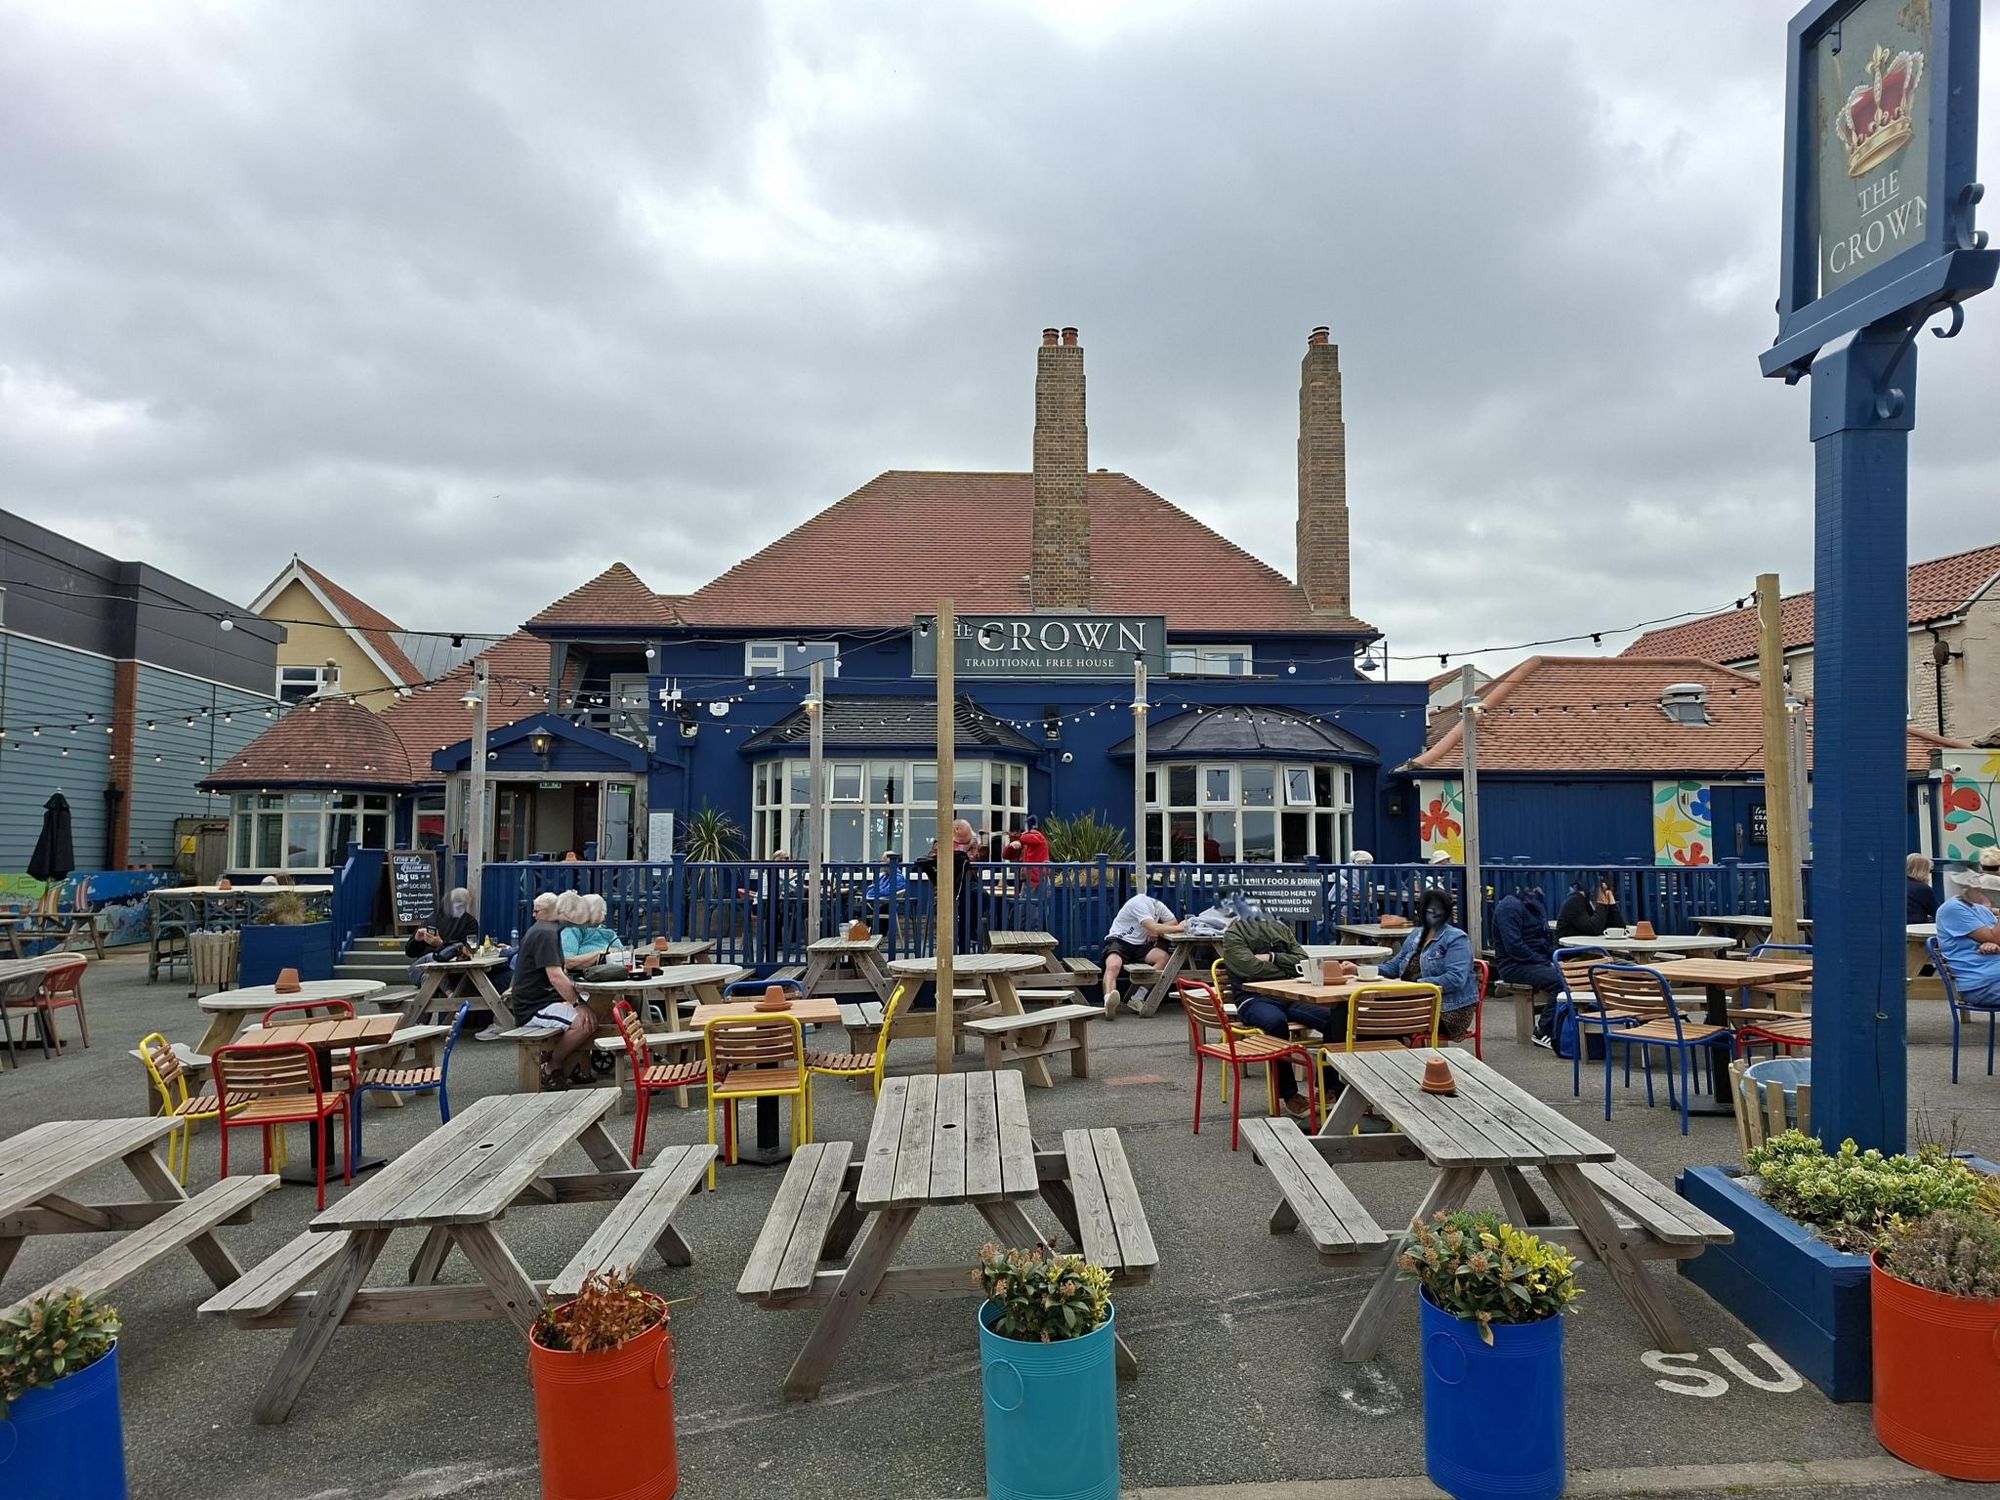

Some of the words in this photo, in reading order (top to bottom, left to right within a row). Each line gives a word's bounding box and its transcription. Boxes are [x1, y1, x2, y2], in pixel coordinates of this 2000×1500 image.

[1858, 170, 1900, 212] THE
[978, 621, 1147, 652] CROWN
[965, 658, 1041, 668] TRADITIONAL
[1046, 658, 1073, 668] FREE
[1075, 658, 1114, 668] HOUSE
